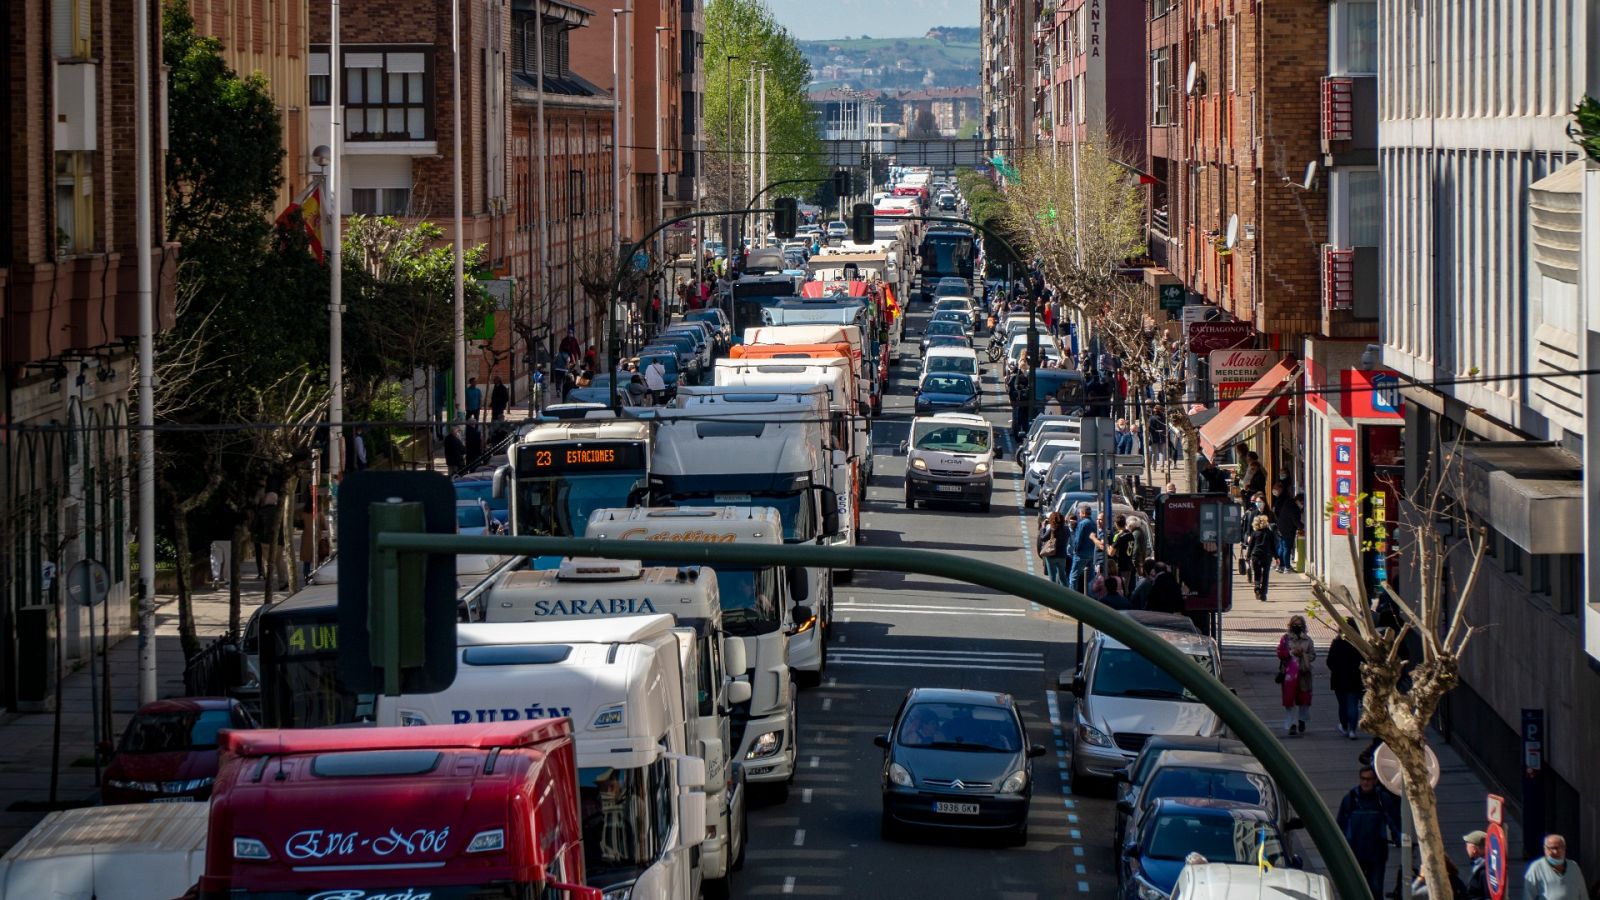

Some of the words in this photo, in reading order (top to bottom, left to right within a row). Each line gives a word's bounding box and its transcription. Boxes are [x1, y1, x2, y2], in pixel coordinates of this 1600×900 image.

[1222, 352, 1267, 367] Mariel
[536, 451, 552, 466] 23
[566, 450, 615, 463] ESTACIONES
[534, 597, 657, 616] SARABIA
[289, 627, 305, 651] 4
